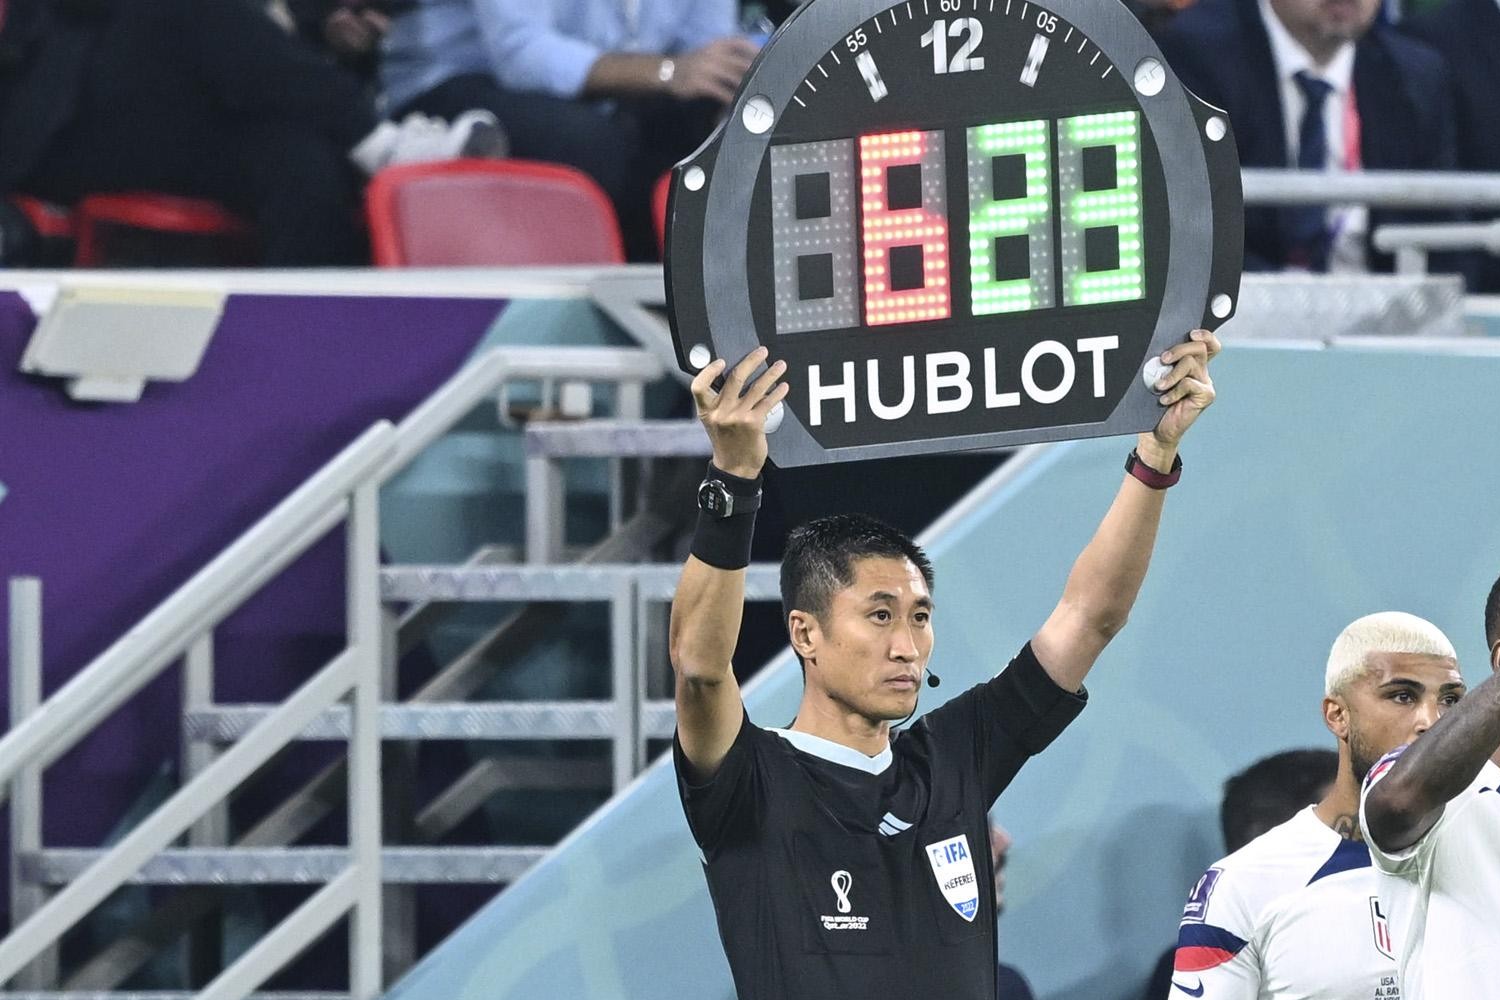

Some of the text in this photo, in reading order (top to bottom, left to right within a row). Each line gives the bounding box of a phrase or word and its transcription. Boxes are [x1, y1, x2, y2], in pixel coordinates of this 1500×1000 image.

[1036, 11, 1058, 33] 05
[845, 28, 868, 53] 55
[920, 17, 985, 75] 12
[860, 110, 1144, 327] 6 23
[807, 334, 1120, 427] HUBLOT
[1374, 987, 1385, 997] AL
[1380, 976, 1395, 986] USA
